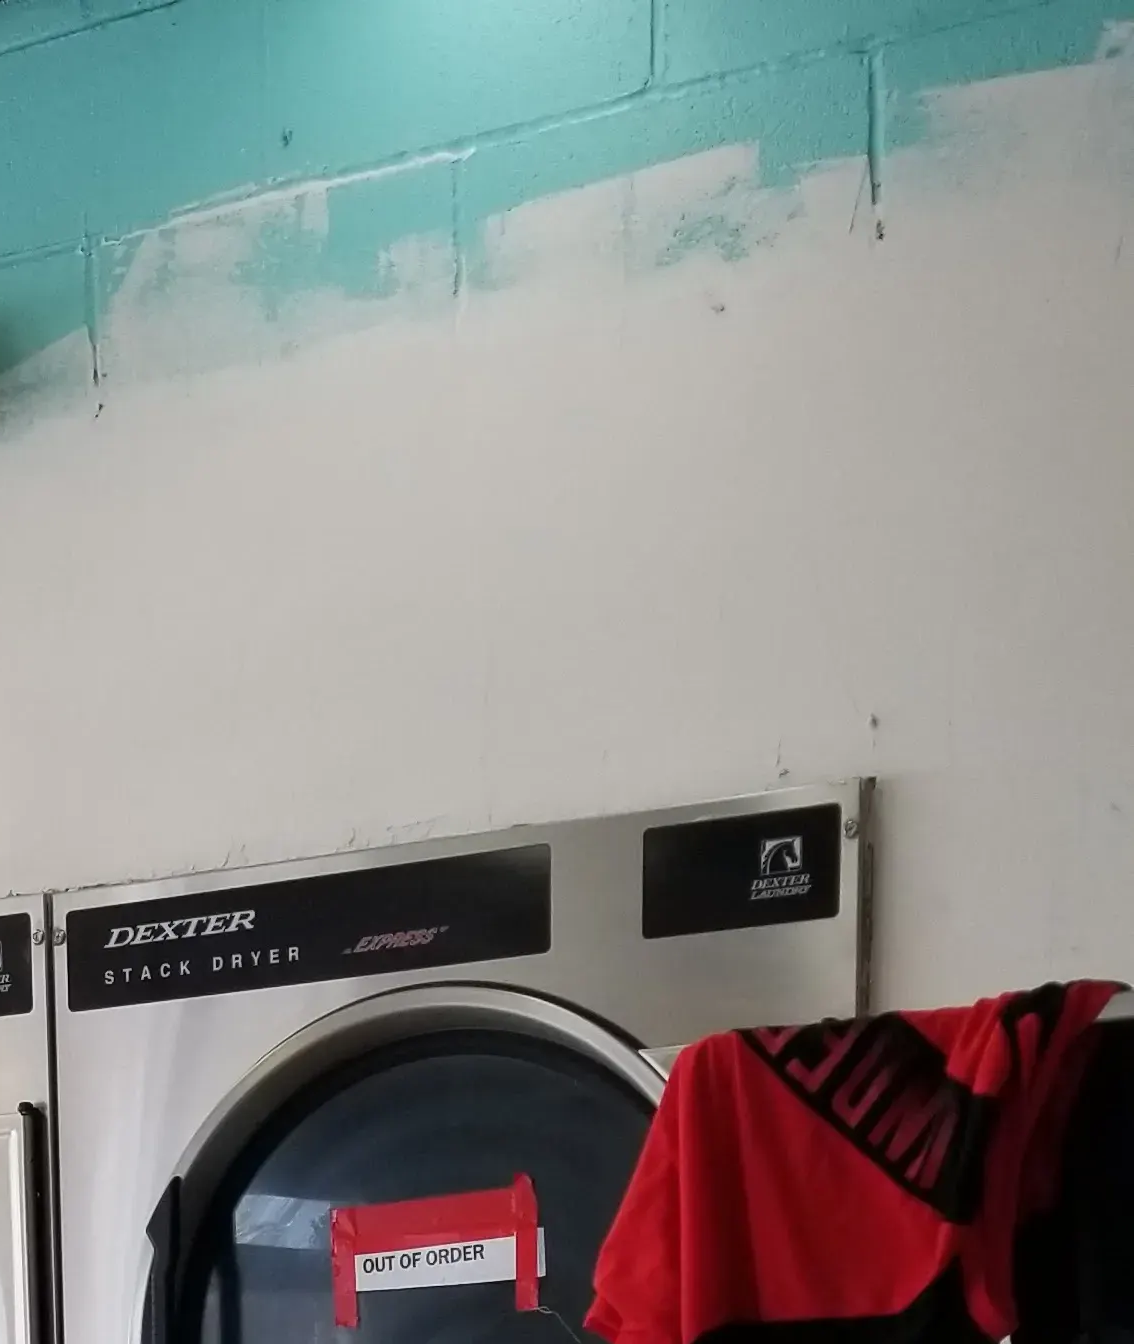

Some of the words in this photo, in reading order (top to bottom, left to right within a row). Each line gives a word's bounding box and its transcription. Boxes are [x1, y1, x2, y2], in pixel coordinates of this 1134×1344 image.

[751, 873, 811, 890] DEXTER
[104, 909, 256, 949] DEXTER
[353, 927, 438, 953] EXPRESS
[104, 960, 191, 985] STACK
[212, 946, 300, 972] DRYER
[362, 1255, 396, 1274] OUT
[399, 1252, 422, 1269] OF
[426, 1244, 485, 1266] ORDER
